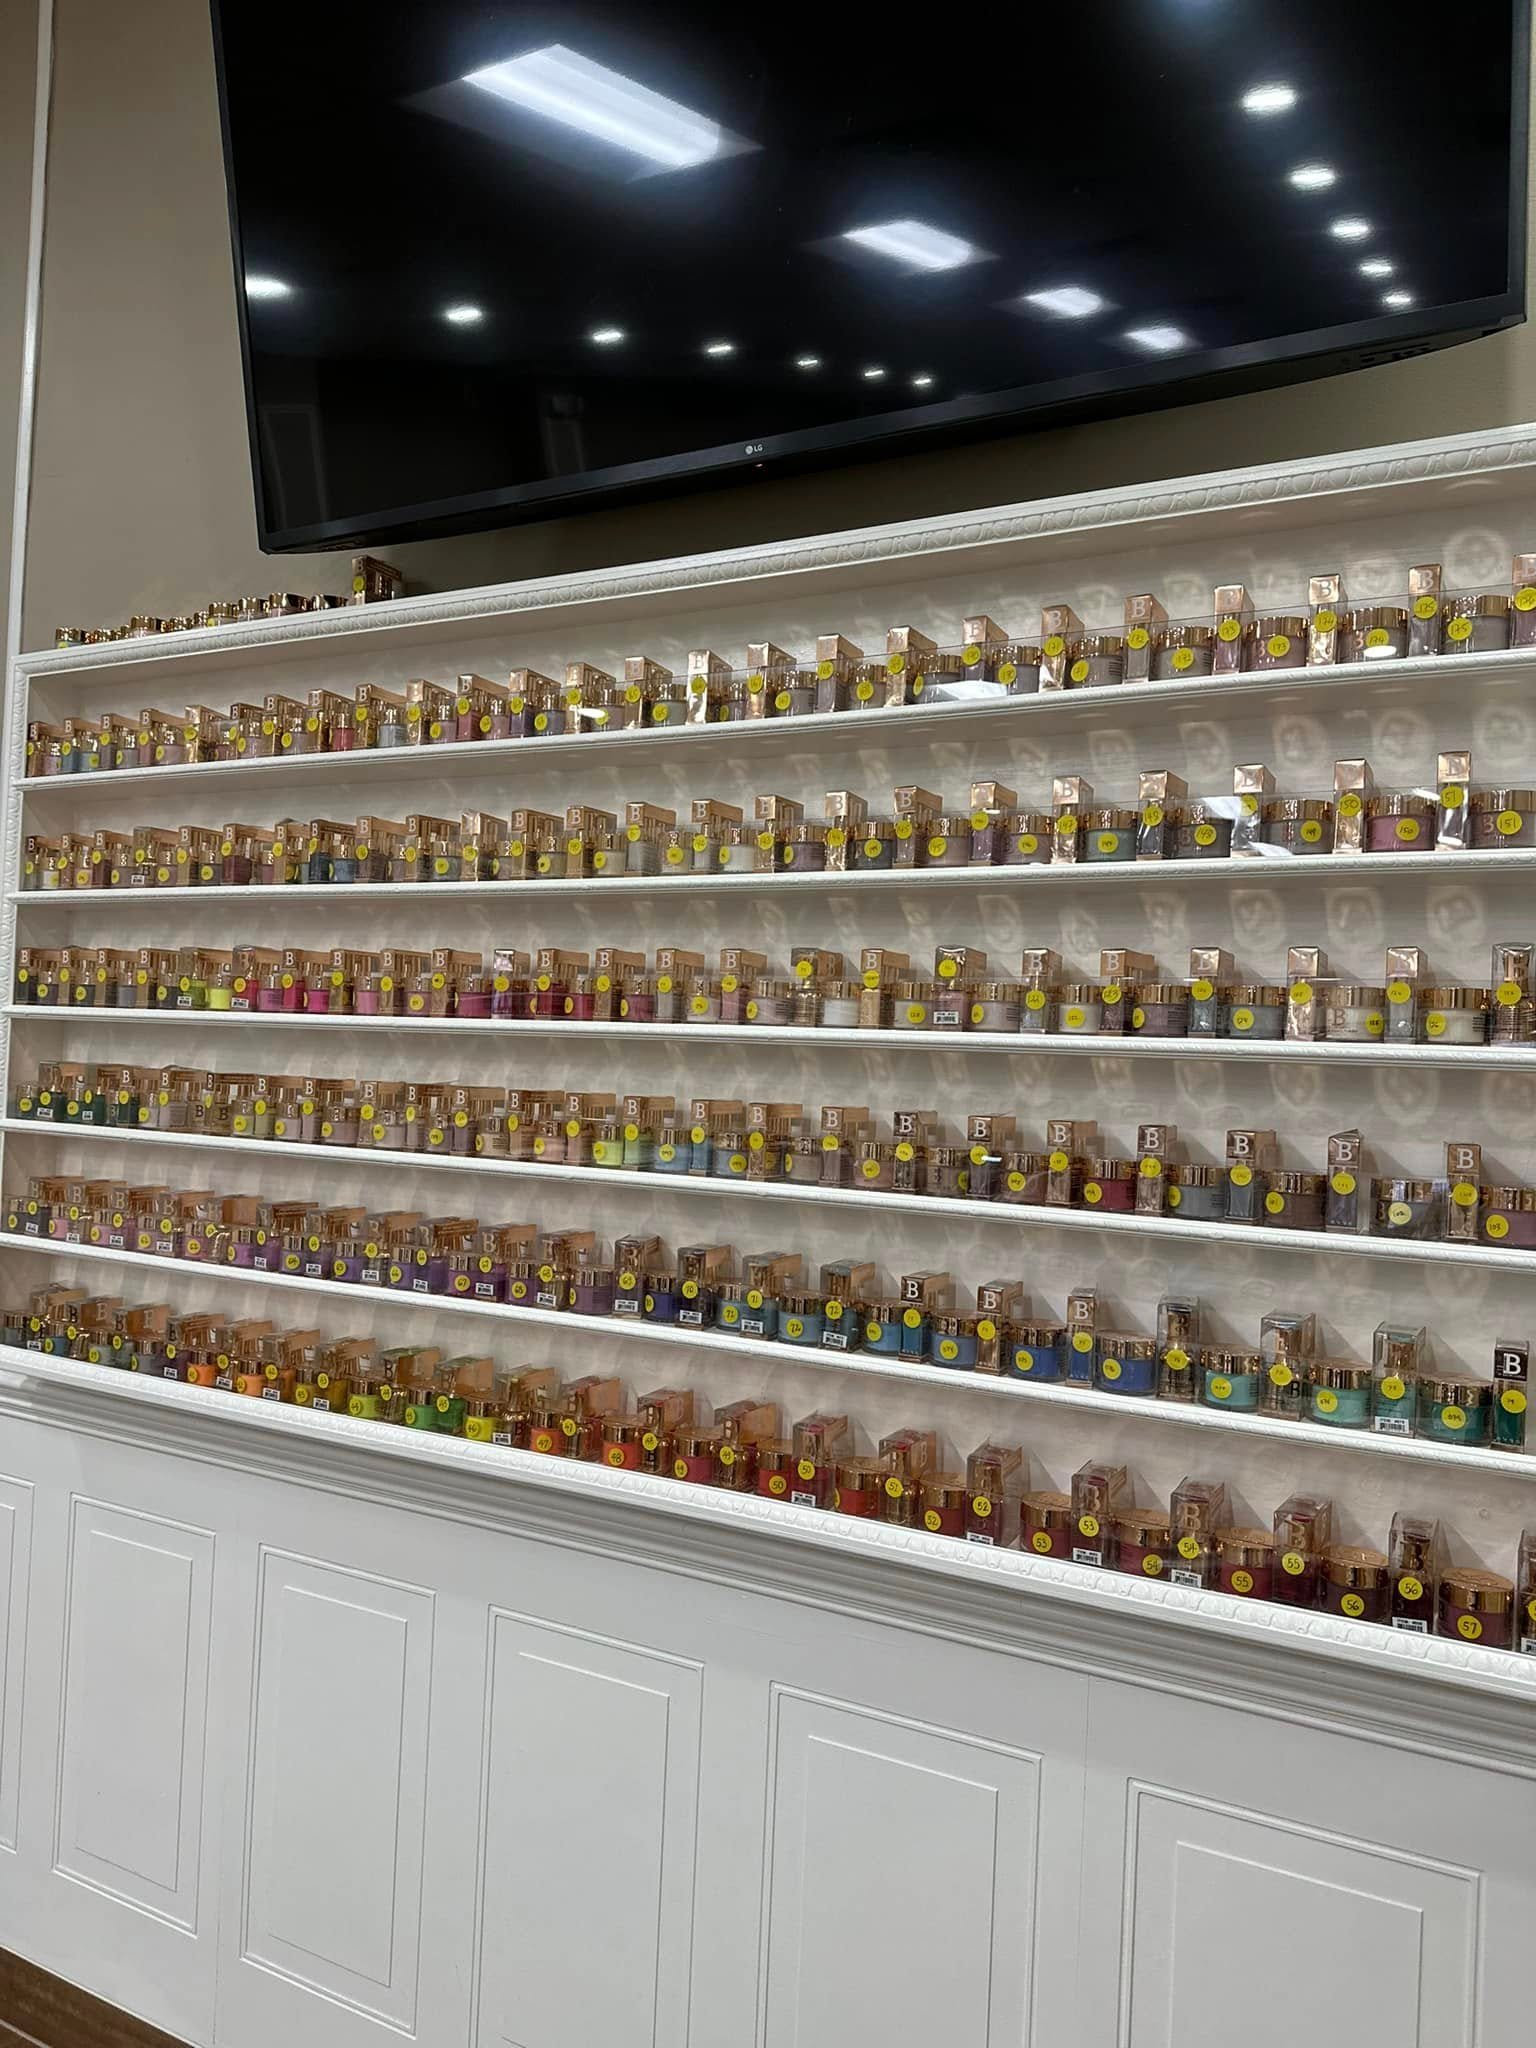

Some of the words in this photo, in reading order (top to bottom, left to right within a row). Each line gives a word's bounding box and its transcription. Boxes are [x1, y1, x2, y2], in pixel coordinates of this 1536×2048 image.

[754, 444, 763, 452] LG
[1418, 570, 1433, 590] B
[1132, 600, 1145, 618] B
[360, 687, 367, 700] B
[901, 792, 912, 807] B
[515, 813, 524, 827] B
[571, 809, 581, 824] B
[632, 806, 640, 821] B
[360, 820, 368, 834] B
[408, 818, 416, 832] B
[1500, 817, 1516, 828] 151
[181, 829, 188, 841] B
[226, 827, 233, 840] B
[277, 826, 284, 839] B
[62, 951, 68, 963] B
[141, 951, 148, 963] B
[286, 952, 293, 965] B
[334, 952, 341, 965] B
[384, 953, 392, 966] B
[436, 953, 445, 967] B
[541, 953, 549, 967] B
[601, 953, 609, 967] B
[662, 953, 671, 968] B
[727, 953, 736, 968] B
[866, 953, 876, 969] B
[1031, 953, 1041, 969] B
[1108, 953, 1118, 971] B
[1334, 1010, 1346, 1025] B
[123, 1070, 129, 1083] B
[162, 1073, 168, 1085] B
[259, 1078, 266, 1092] B
[305, 1080, 312, 1094] B
[365, 1084, 374, 1097] B
[409, 1086, 415, 1100] B
[456, 1089, 465, 1104] B
[511, 1093, 518, 1107] B
[569, 1096, 578, 1111] B
[627, 1100, 637, 1116] B
[695, 1103, 705, 1119] B
[752, 1107, 762, 1123] B
[827, 1110, 838, 1127] B
[900, 1115, 912, 1133] B
[974, 1120, 986, 1137] B
[1054, 1125, 1067, 1142] B
[1147, 1129, 1159, 1148] B
[1235, 1136, 1249, 1155] B
[1338, 1142, 1352, 1161] B
[1458, 1148, 1473, 1168] B
[73, 1188, 81, 1203] B
[482, 1232, 495, 1252] B
[907, 1280, 918, 1298] B
[983, 1290, 996, 1309] B
[828, 1306, 839, 1315] 72
[1075, 1301, 1089, 1320] B
[1504, 1354, 1521, 1375] B
[773, 1481, 783, 1489] 50
[977, 1500, 989, 1512] 52
[927, 1515, 937, 1526] 52
[1084, 1521, 1094, 1530] 53
[1037, 1538, 1047, 1548] 53
[1184, 1542, 1197, 1553] 54
[1147, 1560, 1158, 1571] 54
[1287, 1558, 1300, 1569] 55
[1236, 1576, 1248, 1588] 55
[1405, 1583, 1417, 1595] 56
[1347, 1599, 1359, 1610] 56
[1462, 1621, 1477, 1634] 57
